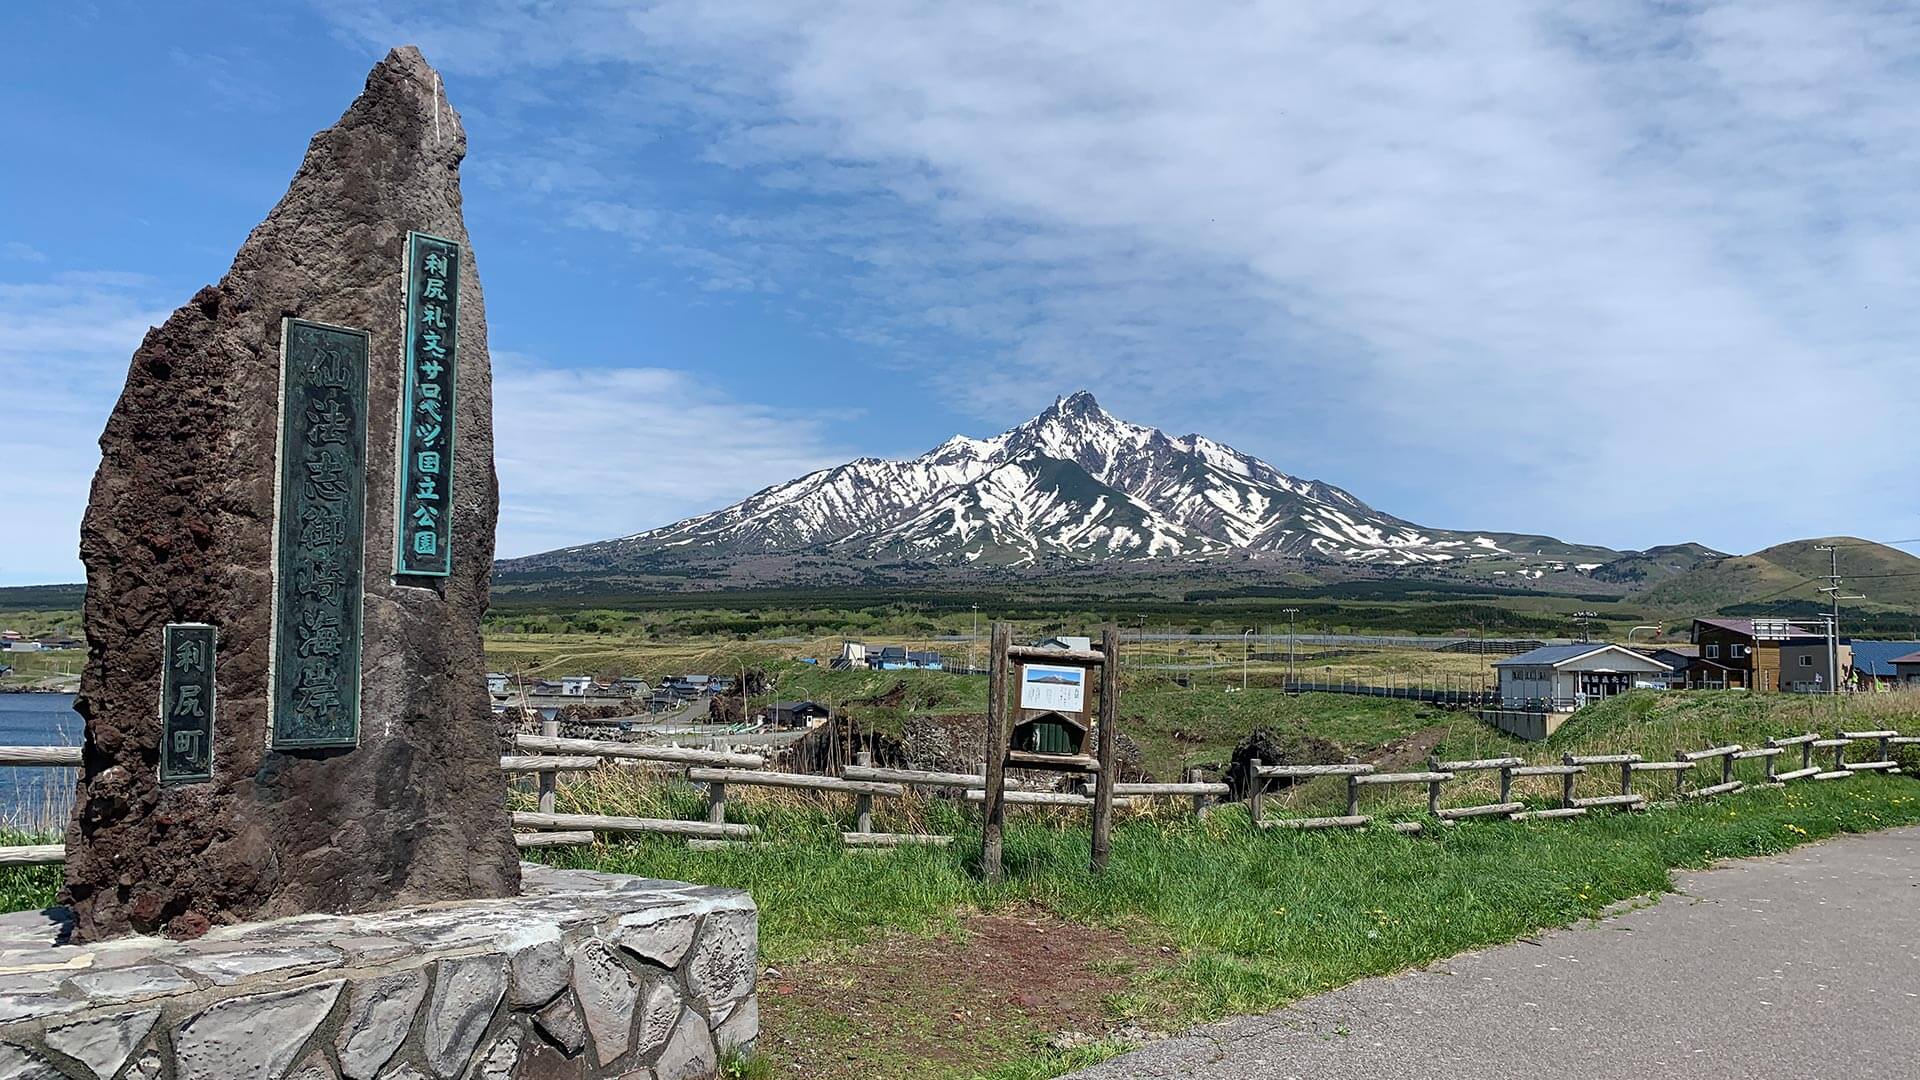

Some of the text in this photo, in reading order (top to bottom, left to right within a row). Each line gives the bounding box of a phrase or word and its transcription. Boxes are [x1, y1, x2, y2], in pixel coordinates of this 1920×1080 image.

[298, 349, 352, 717] 仙法志御崎海岸
[174, 640, 206, 762] 利尻町
